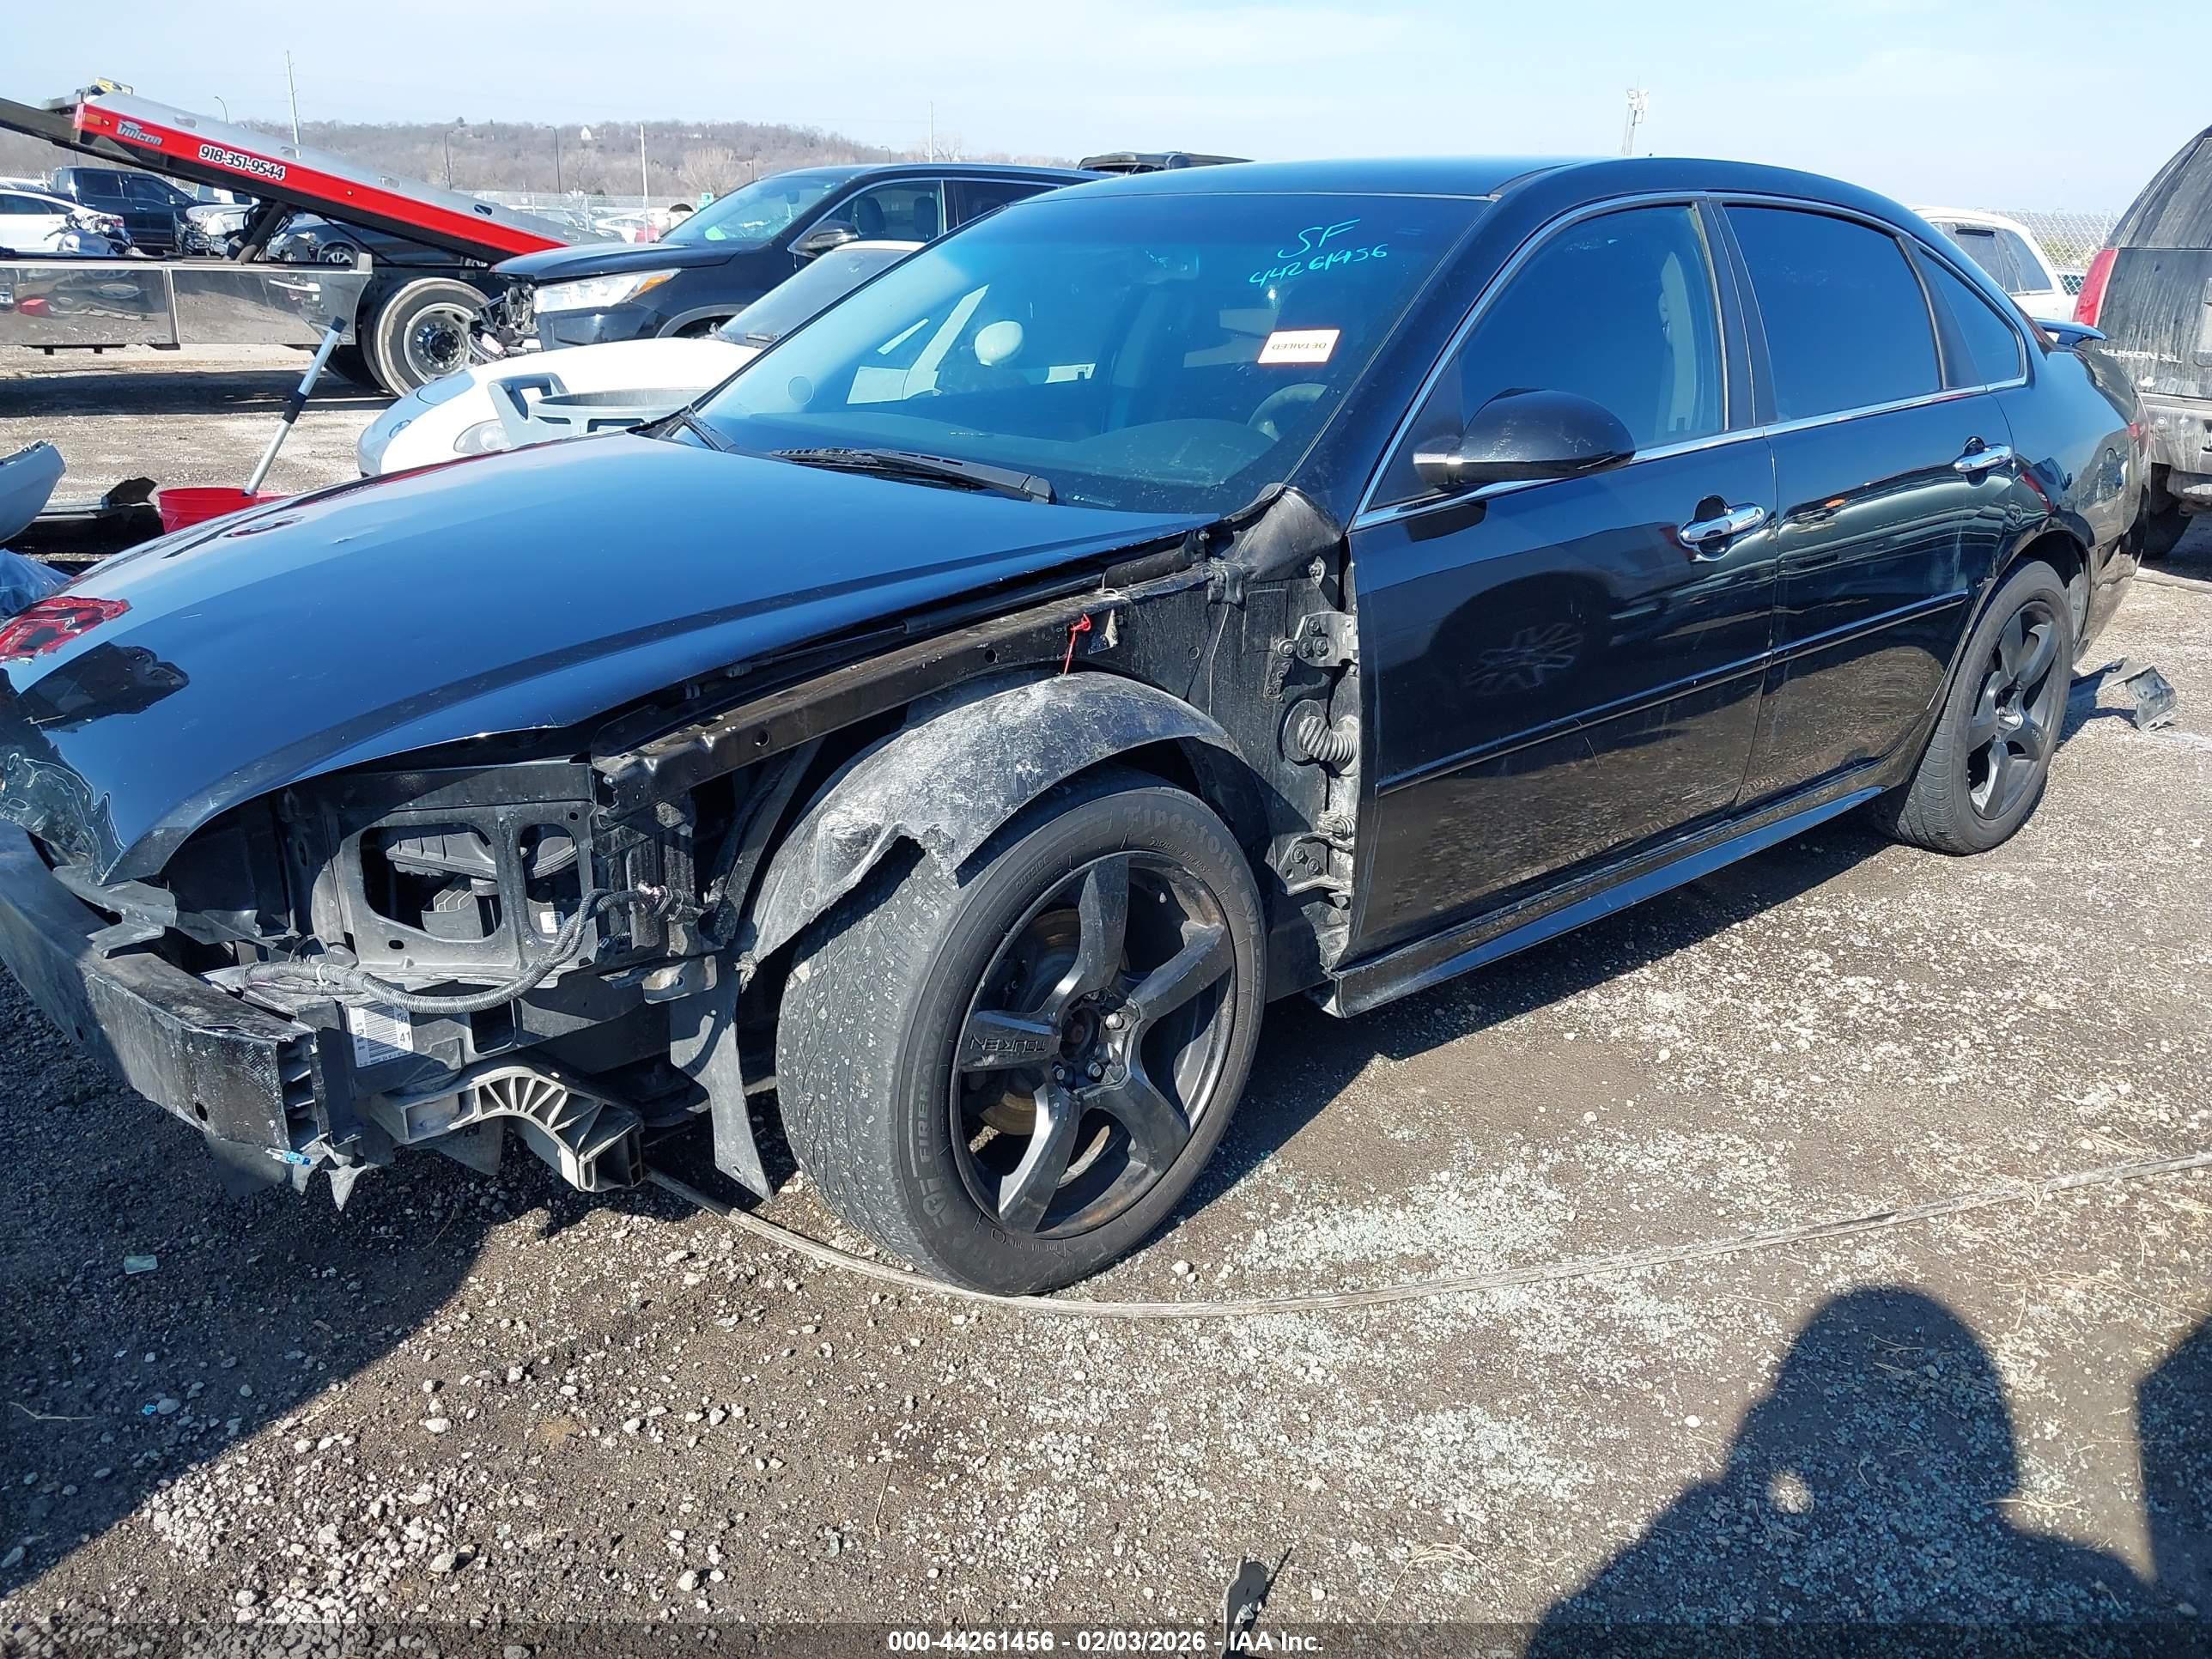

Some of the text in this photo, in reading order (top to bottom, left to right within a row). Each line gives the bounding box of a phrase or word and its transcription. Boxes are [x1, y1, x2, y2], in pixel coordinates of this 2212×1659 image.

[199, 144, 285, 179] 918-351-9544
[1278, 218, 1360, 258] SF
[1272, 342, 1327, 350] DETAILED
[1123, 805, 1242, 884] Firestone
[1015, 854, 1051, 890] OUTSIDE
[970, 1034, 1047, 1053] TOUREN
